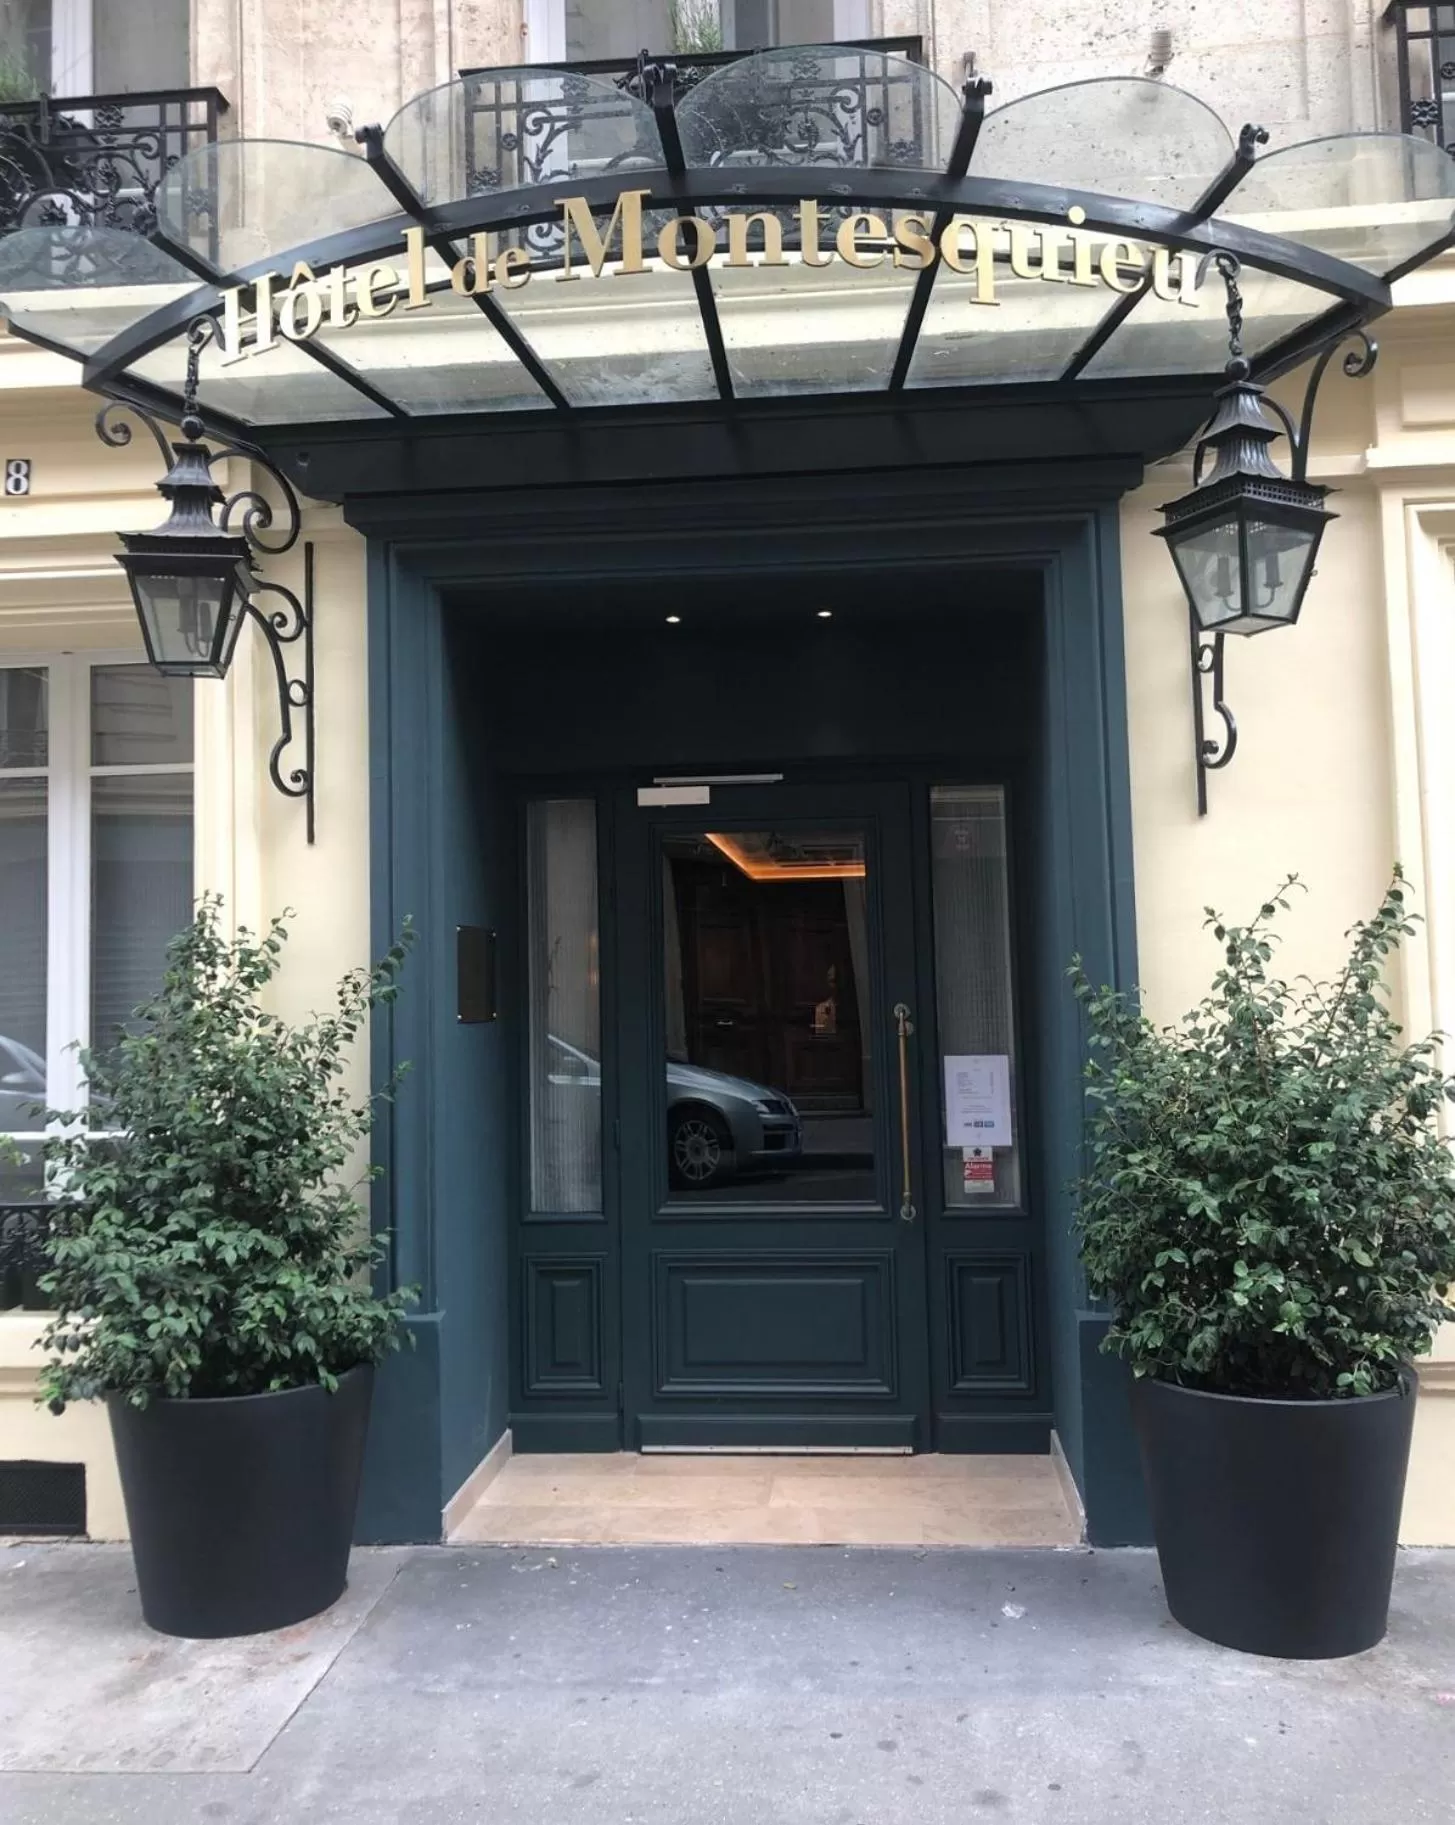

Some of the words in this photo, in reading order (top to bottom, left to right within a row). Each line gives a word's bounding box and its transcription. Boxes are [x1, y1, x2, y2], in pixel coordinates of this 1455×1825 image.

[219, 226, 432, 367] Hôtel
[451, 231, 532, 297] de
[554, 188, 1200, 308] Montesquieu
[7, 460, 28, 495] 8
